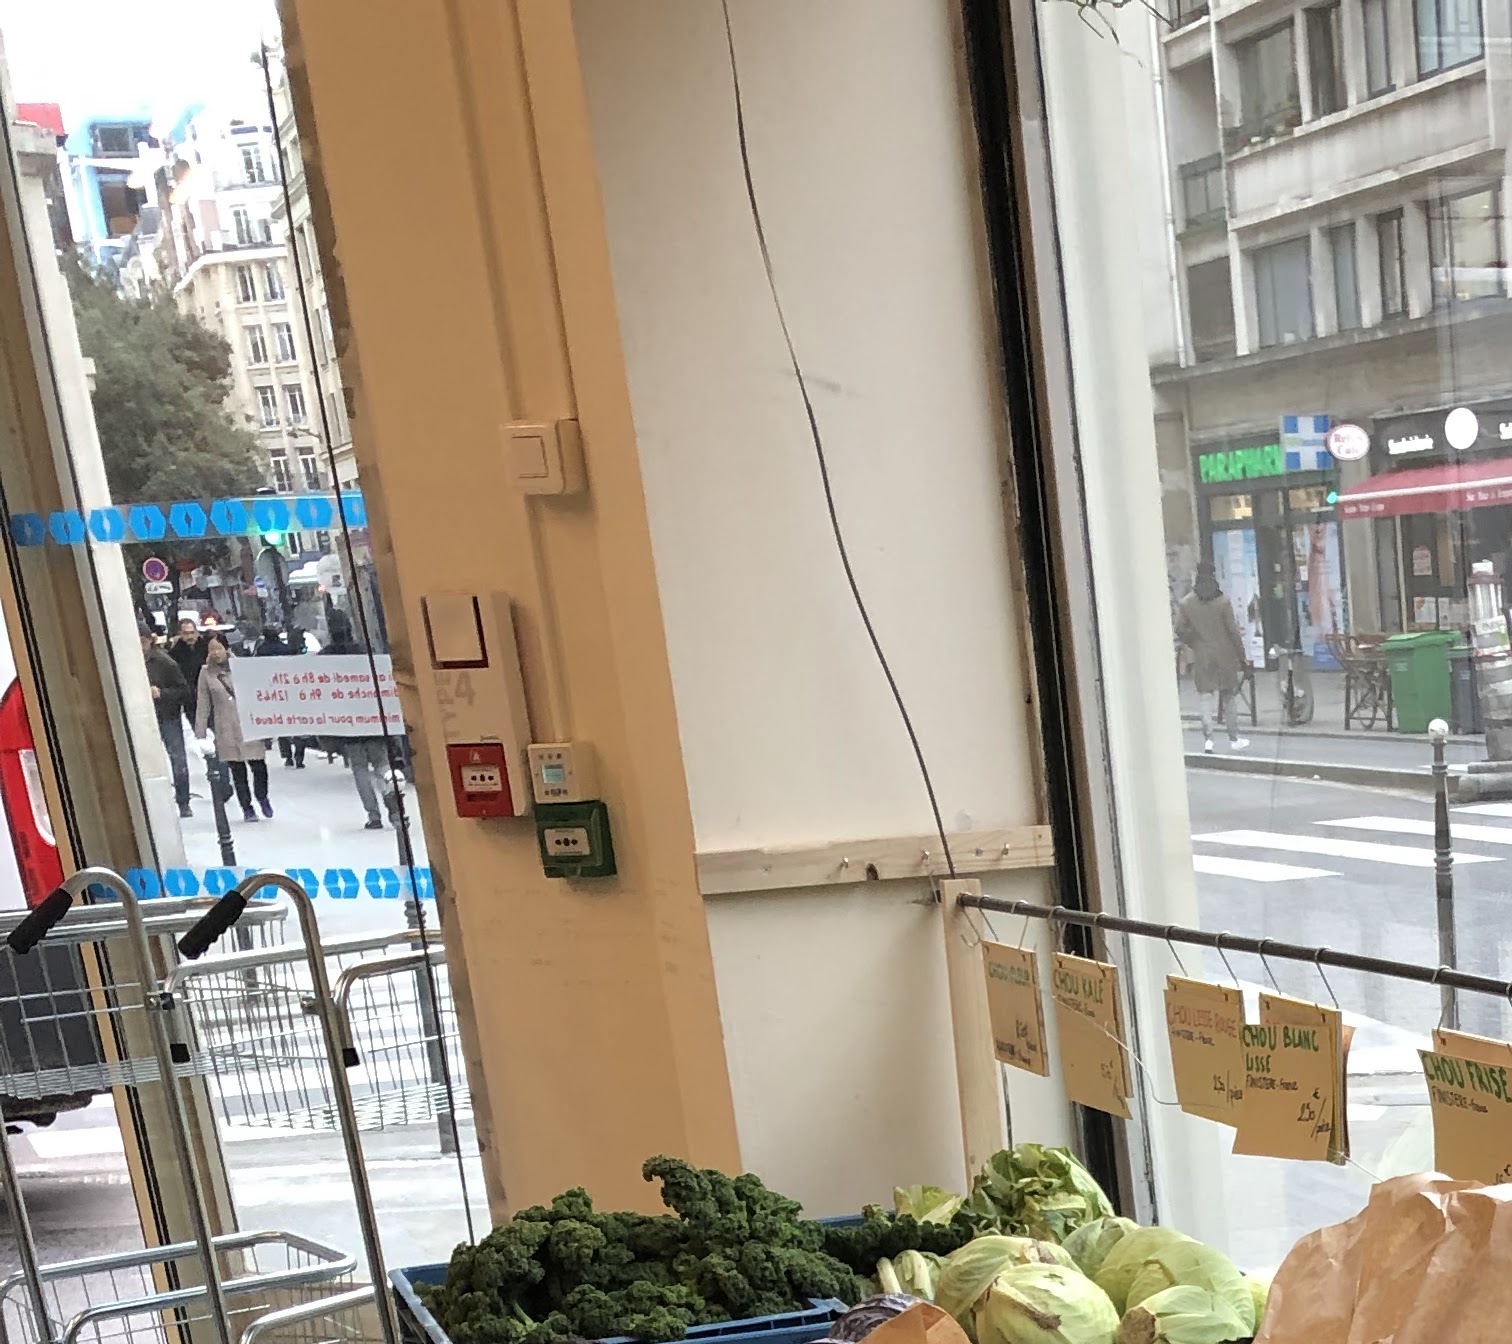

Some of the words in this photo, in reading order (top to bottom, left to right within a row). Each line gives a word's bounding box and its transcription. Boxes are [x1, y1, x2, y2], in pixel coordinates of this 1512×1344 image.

[1053, 968, 1079, 996] CHOU
[1242, 1025, 1277, 1051] CHOU
[1283, 1026, 1320, 1052] BLANC
[1246, 1054, 1272, 1074] LISSE
[1421, 1053, 1465, 1089] CHOU
[1465, 1059, 1512, 1104] FRISE
